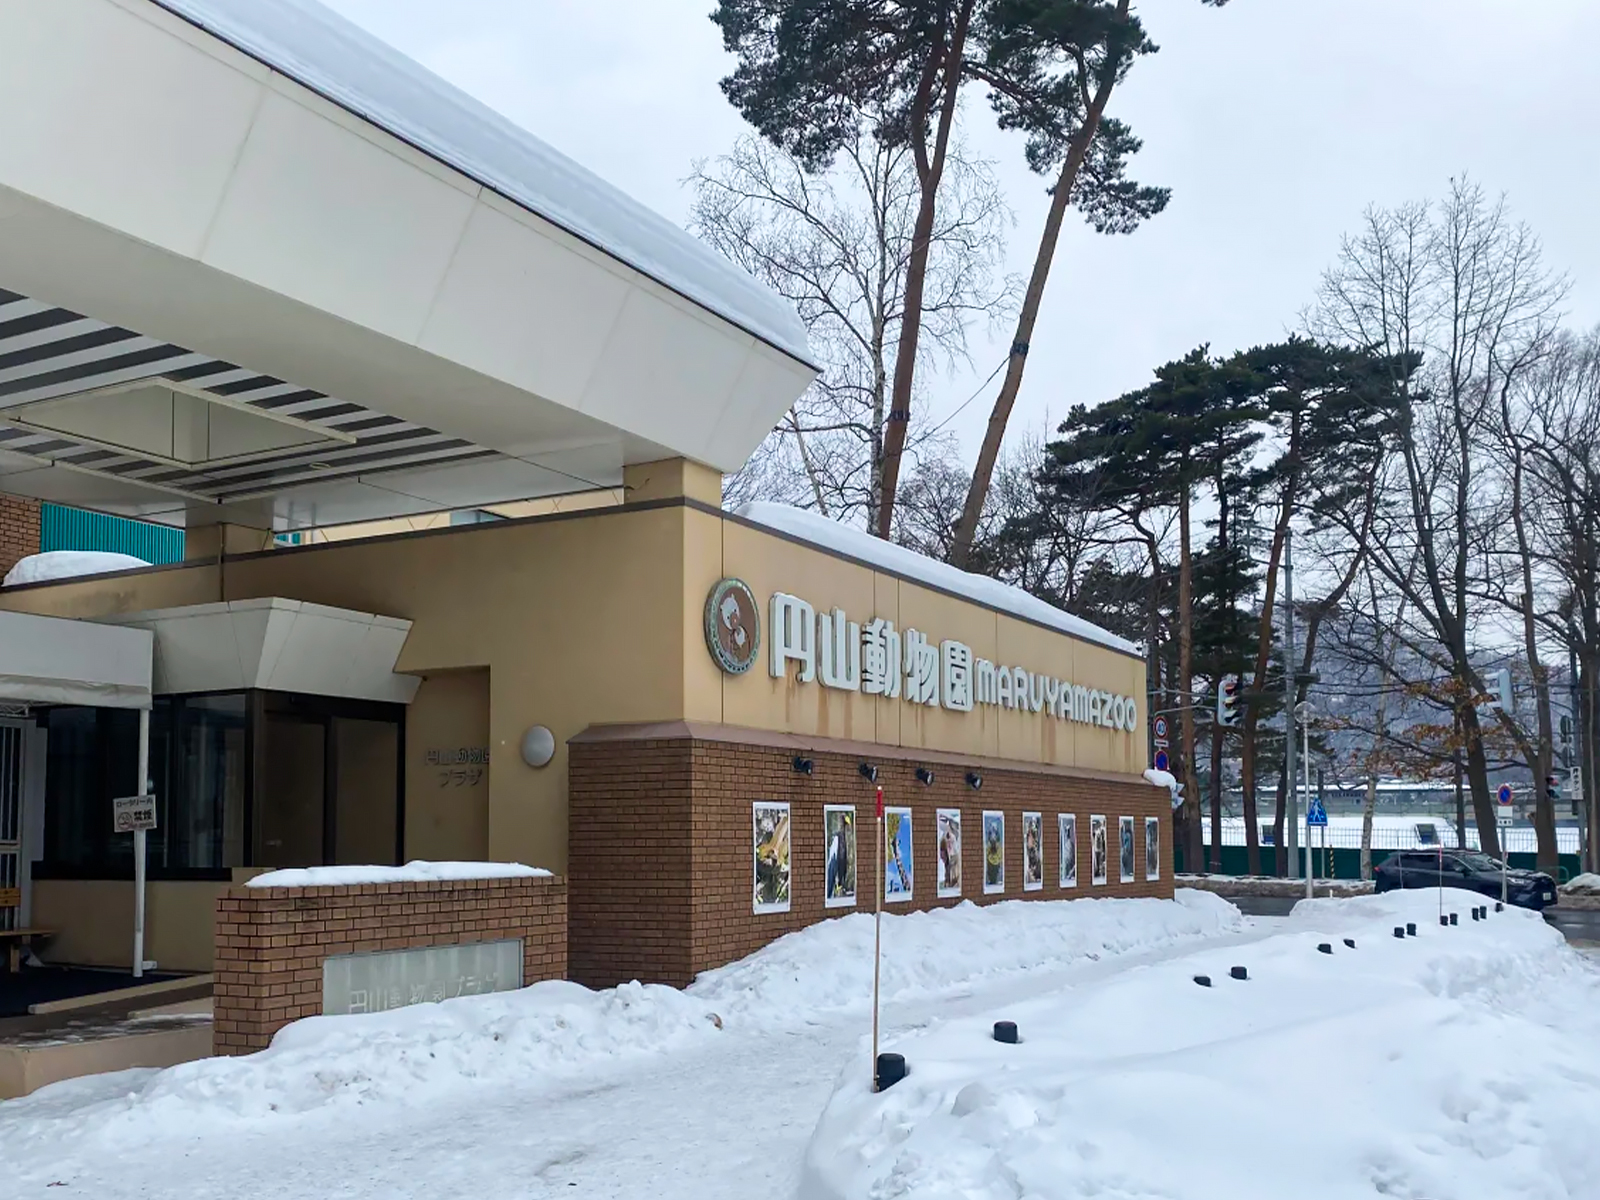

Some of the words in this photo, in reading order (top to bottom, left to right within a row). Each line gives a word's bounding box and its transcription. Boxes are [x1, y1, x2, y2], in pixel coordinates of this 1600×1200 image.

[769, 592, 973, 711] 円山動物園
